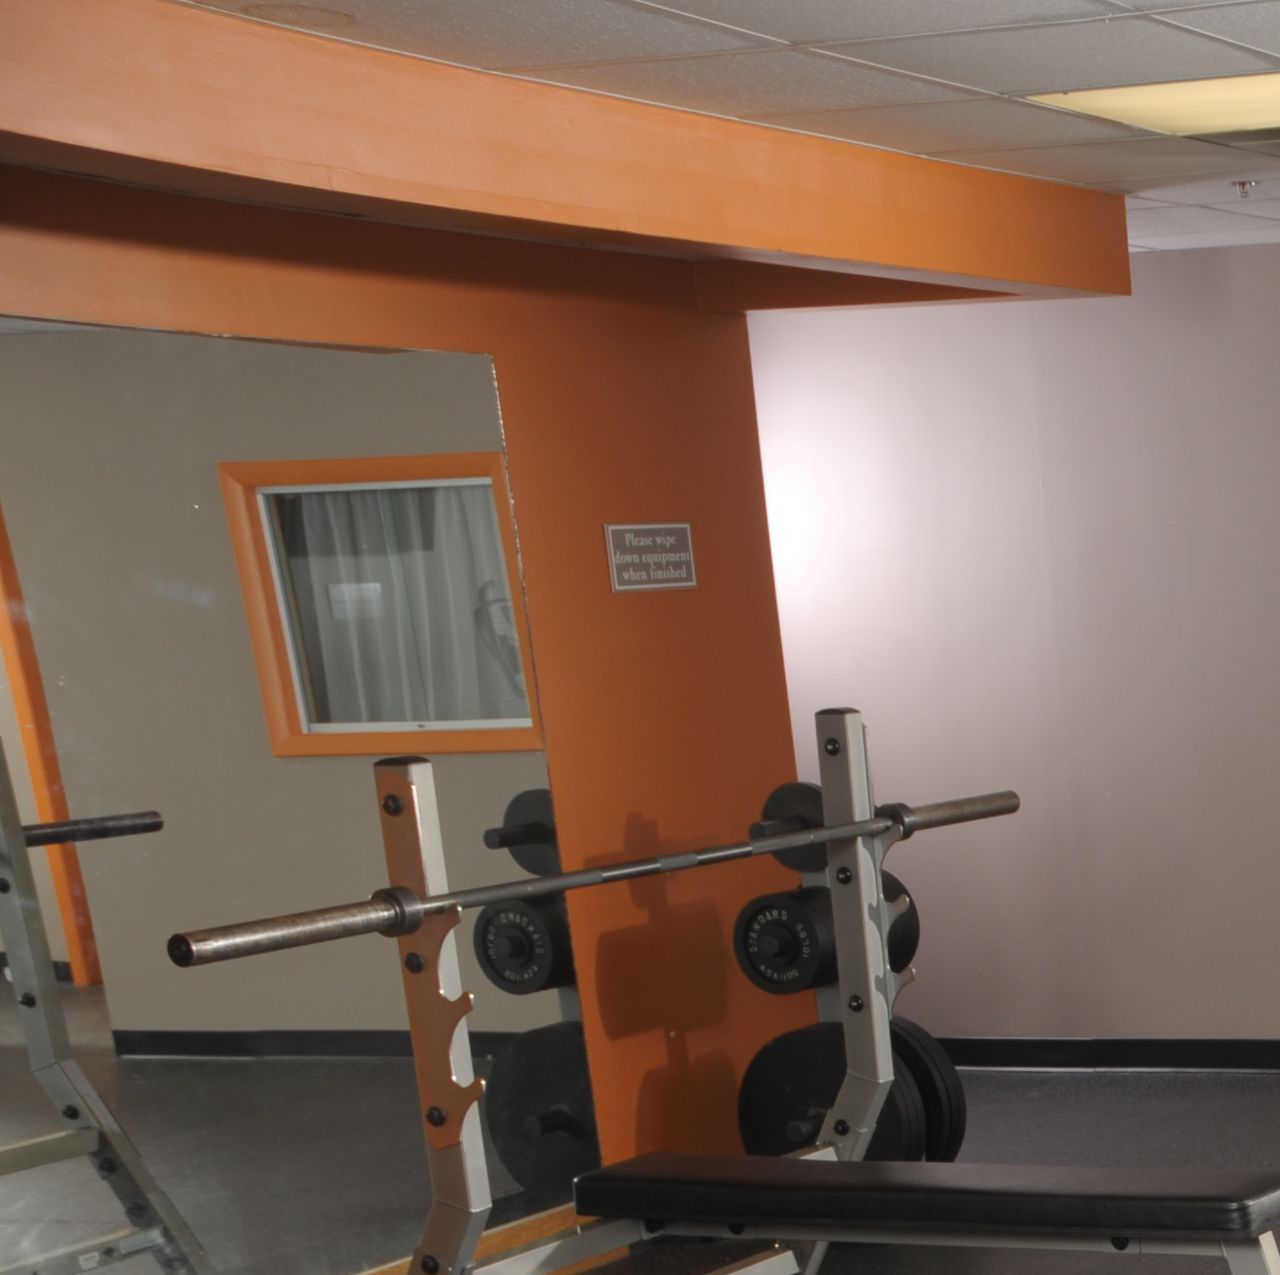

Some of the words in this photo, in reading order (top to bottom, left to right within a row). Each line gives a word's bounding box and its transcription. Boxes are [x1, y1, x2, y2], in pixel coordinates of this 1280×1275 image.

[624, 532, 653, 547] Please
[655, 532, 677, 549] wipe
[614, 550, 640, 565] down
[642, 549, 690, 567] equipment
[622, 567, 648, 581] when
[649, 565, 687, 580] finished
